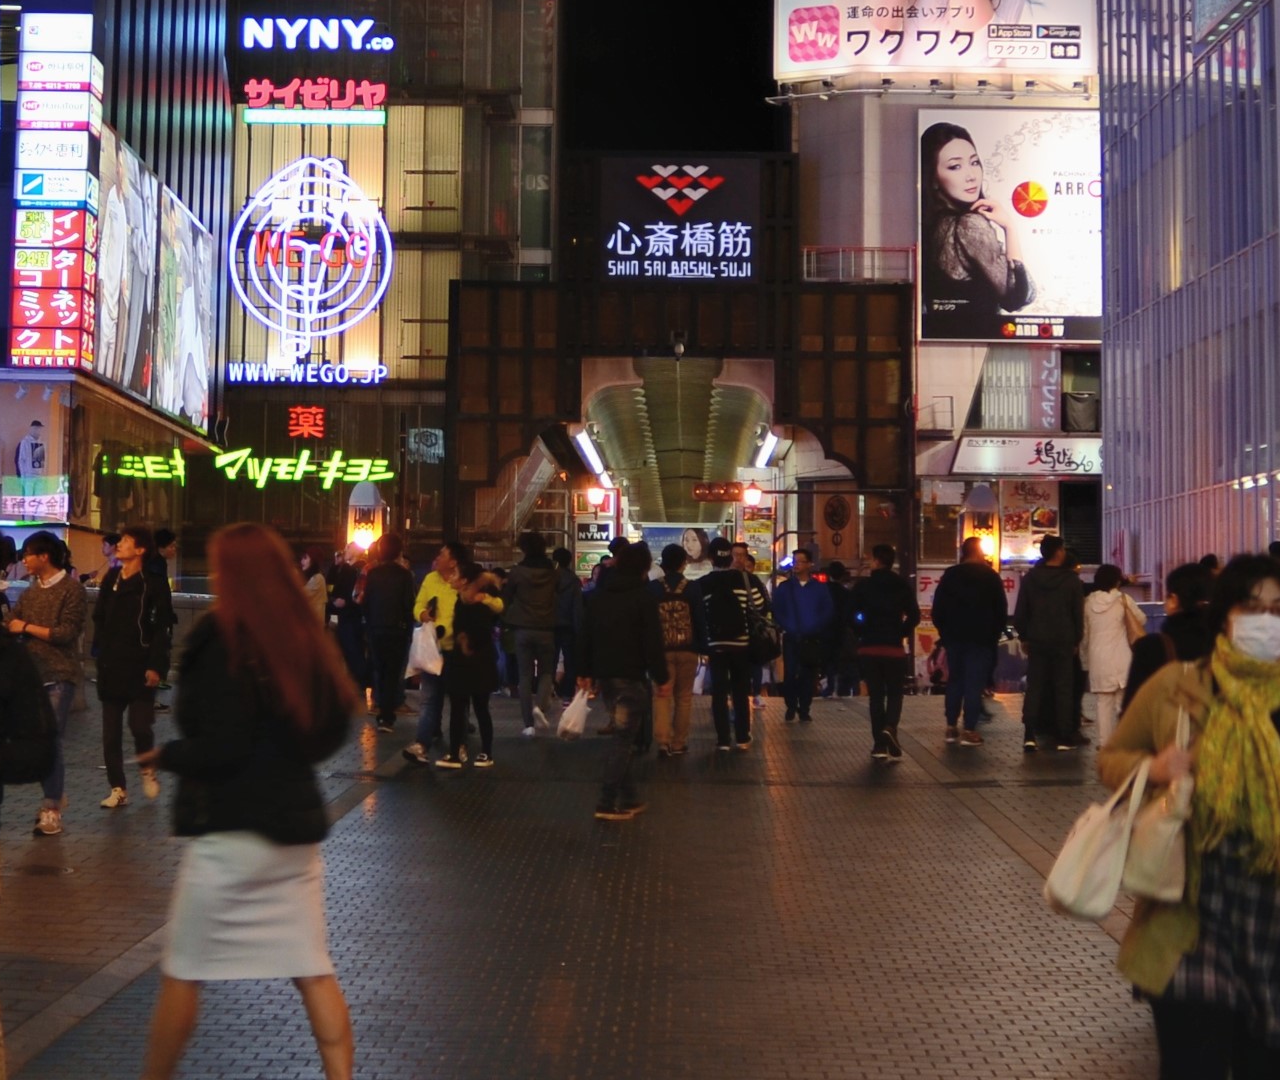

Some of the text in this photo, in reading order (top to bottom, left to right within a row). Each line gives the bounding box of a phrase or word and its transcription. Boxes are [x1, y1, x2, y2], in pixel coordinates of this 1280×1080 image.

[847, 6, 977, 20] 運命の出会いアプリ
[243, 18, 395, 51] NYNY.co
[846, 29, 976, 57] ワクワク
[994, 45, 1040, 55] ワクワク
[243, 77, 387, 110] サイゼリヤ
[1054, 180, 1101, 198] ARRO
[255, 230, 371, 268] WE GO
[607, 221, 752, 257] 心斎橋筋
[17, 250, 49, 267] 24H
[608, 260, 639, 276] SHIN
[644, 260, 666, 276] SAI
[50, 211, 81, 349] インターネット
[16, 270, 45, 349] コミック
[1016, 323, 1065, 338] ARROW
[229, 361, 389, 384] WWW.WEGO.JP
[288, 406, 326, 438] 薬
[215, 447, 395, 489] マツモトキヨシ
[578, 532, 609, 540] NYNY
